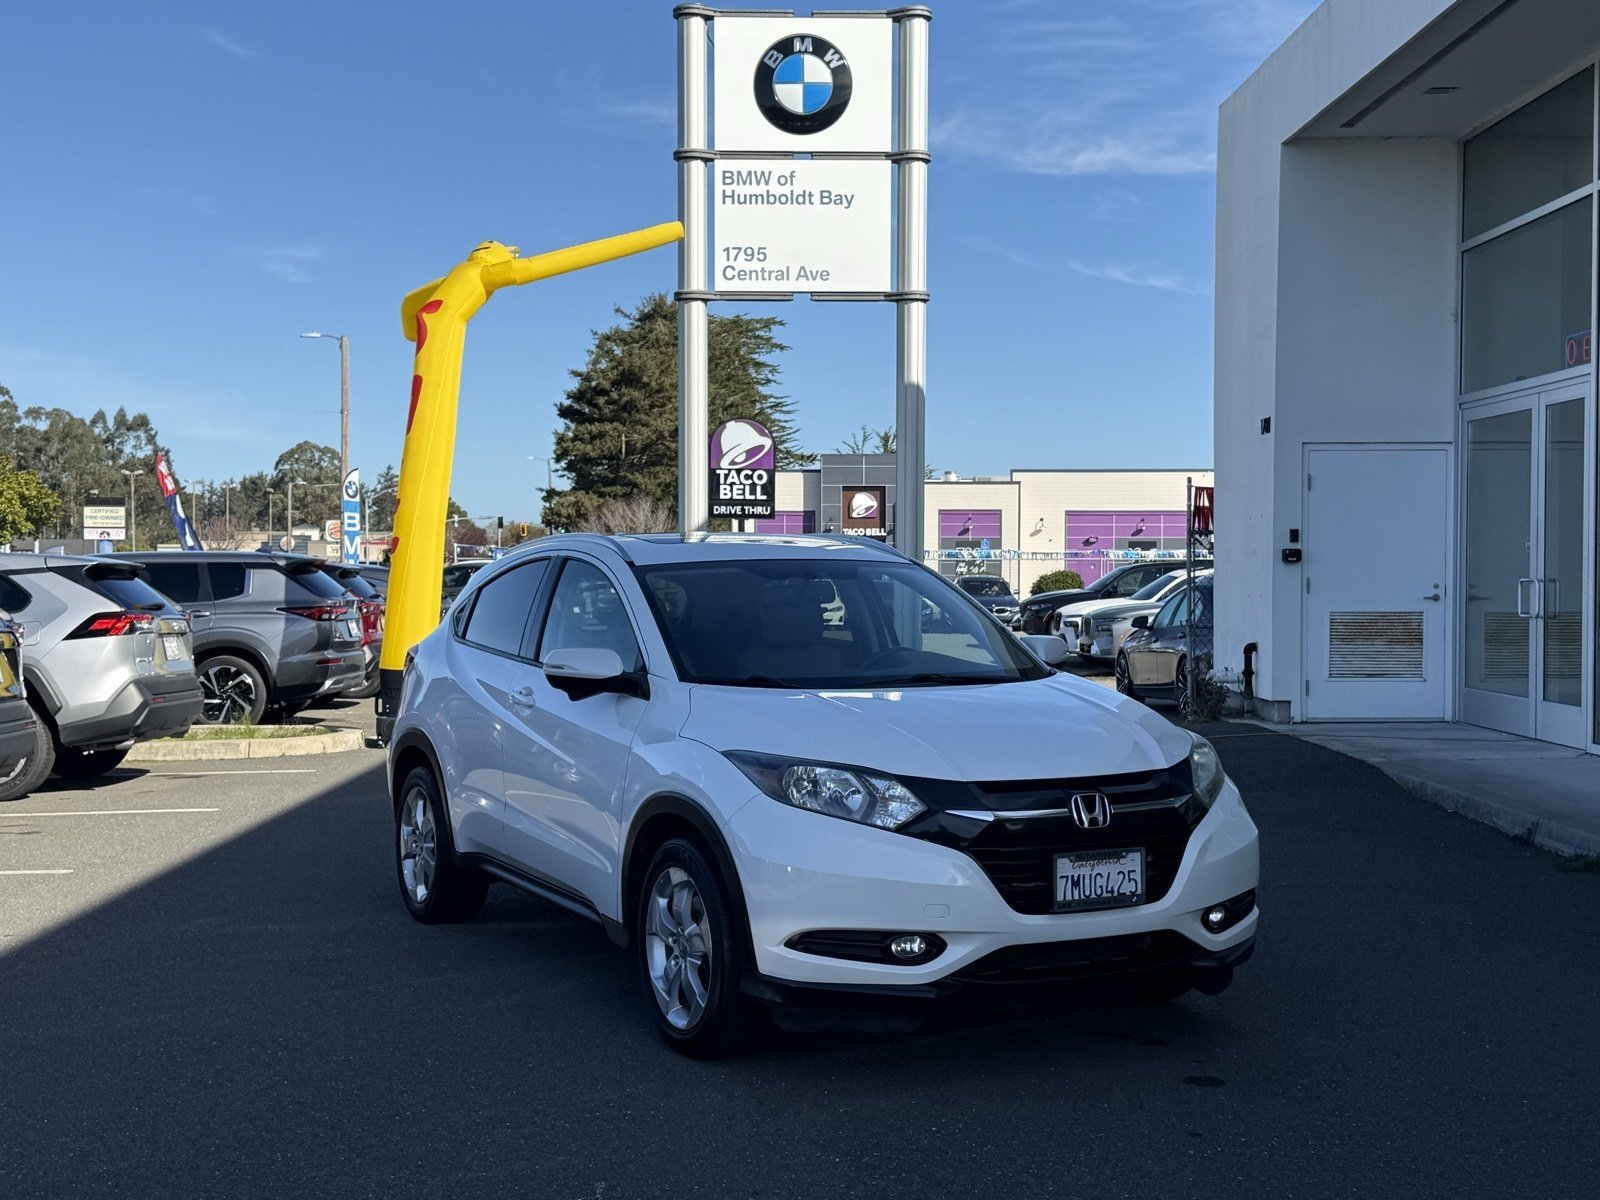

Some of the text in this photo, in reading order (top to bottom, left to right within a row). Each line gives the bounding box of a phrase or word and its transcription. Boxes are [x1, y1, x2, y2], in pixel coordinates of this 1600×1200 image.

[763, 37, 844, 69] BMW
[721, 170, 796, 186] BMW of
[721, 189, 855, 209] Humboldt Bay
[722, 246, 767, 262] 1795
[722, 265, 831, 281] Central Ave
[715, 469, 768, 485] TACO
[719, 484, 767, 500] BELL
[713, 505, 771, 515] DRIVE THRU
[842, 528, 887, 536] TACO BELL
[1059, 870, 1138, 900] 7MUG425
